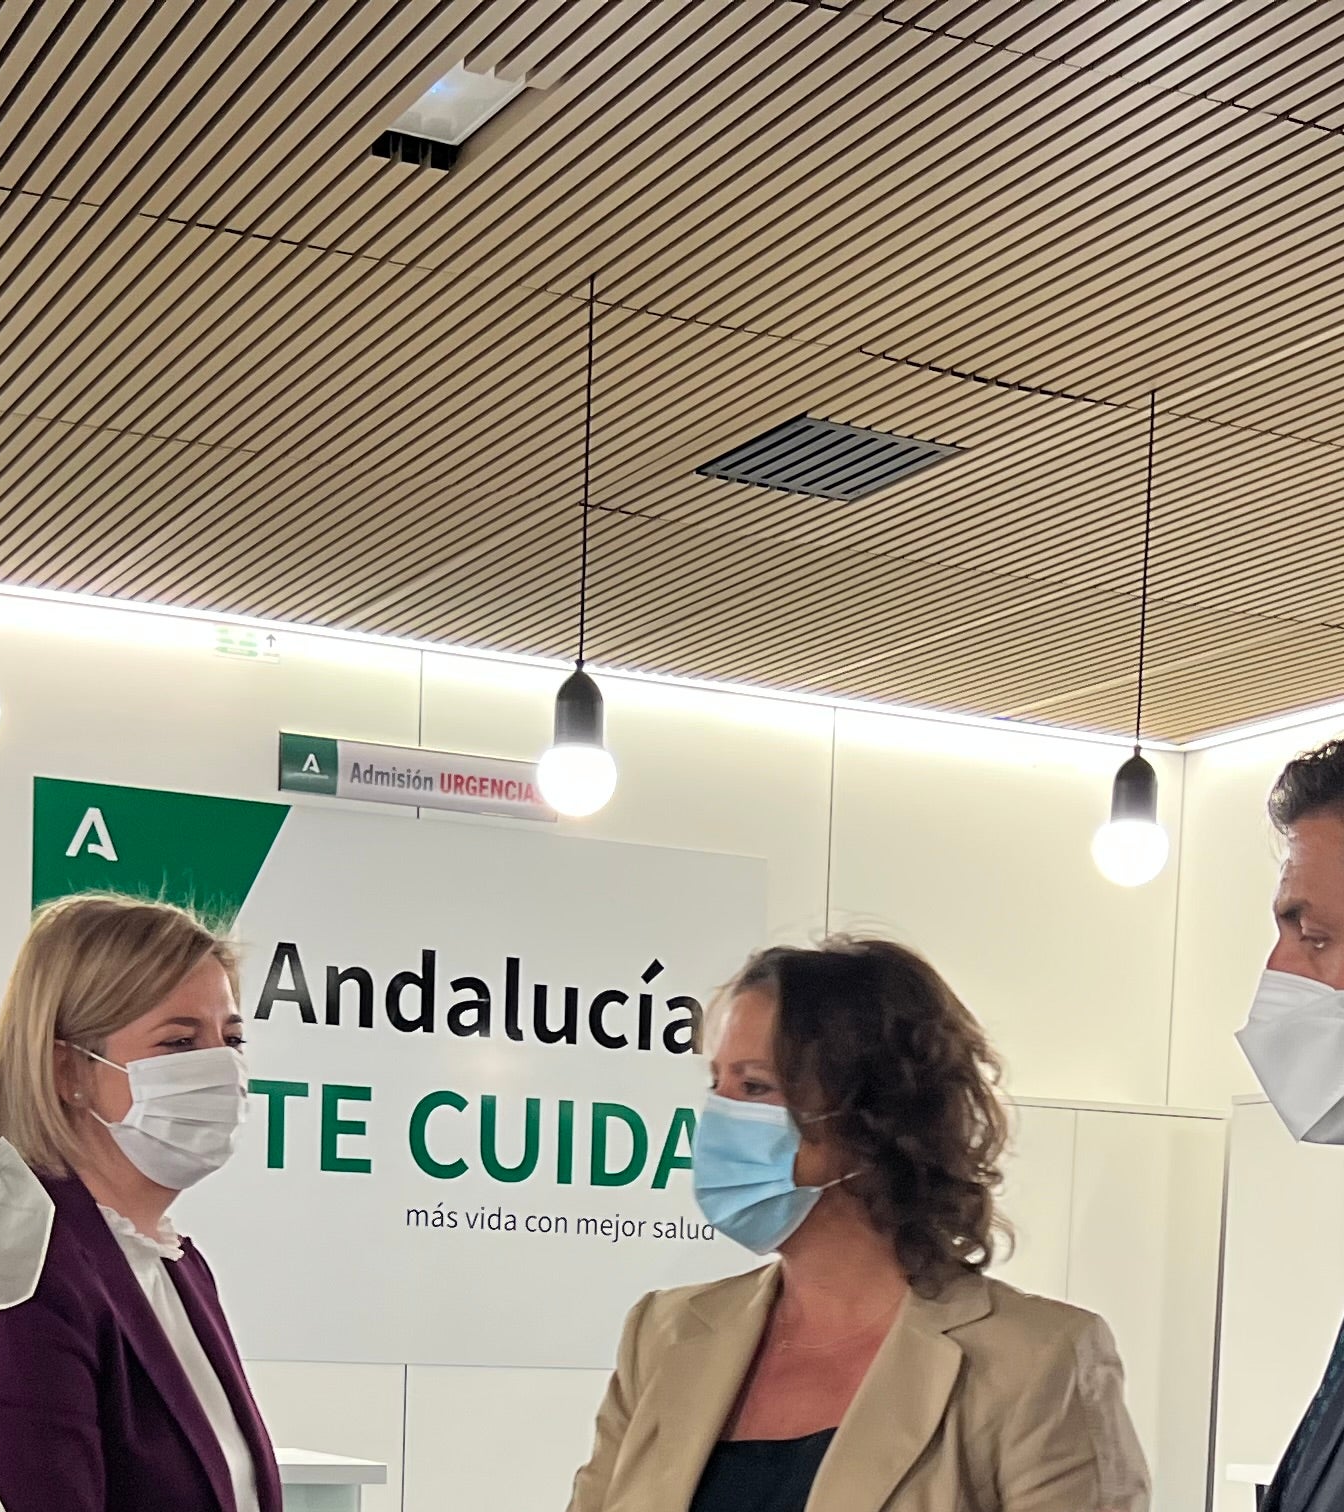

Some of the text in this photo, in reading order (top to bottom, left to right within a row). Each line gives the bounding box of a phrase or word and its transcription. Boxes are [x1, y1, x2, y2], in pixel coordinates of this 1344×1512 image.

[349, 762, 545, 805] Admisión URGENCIA
[253, 940, 705, 1056] Andalucía
[247, 1078, 373, 1175] TE
[406, 1202, 458, 1229] más
[465, 1206, 517, 1232] vida
[525, 1214, 568, 1234] con
[576, 1214, 647, 1243] mejor
